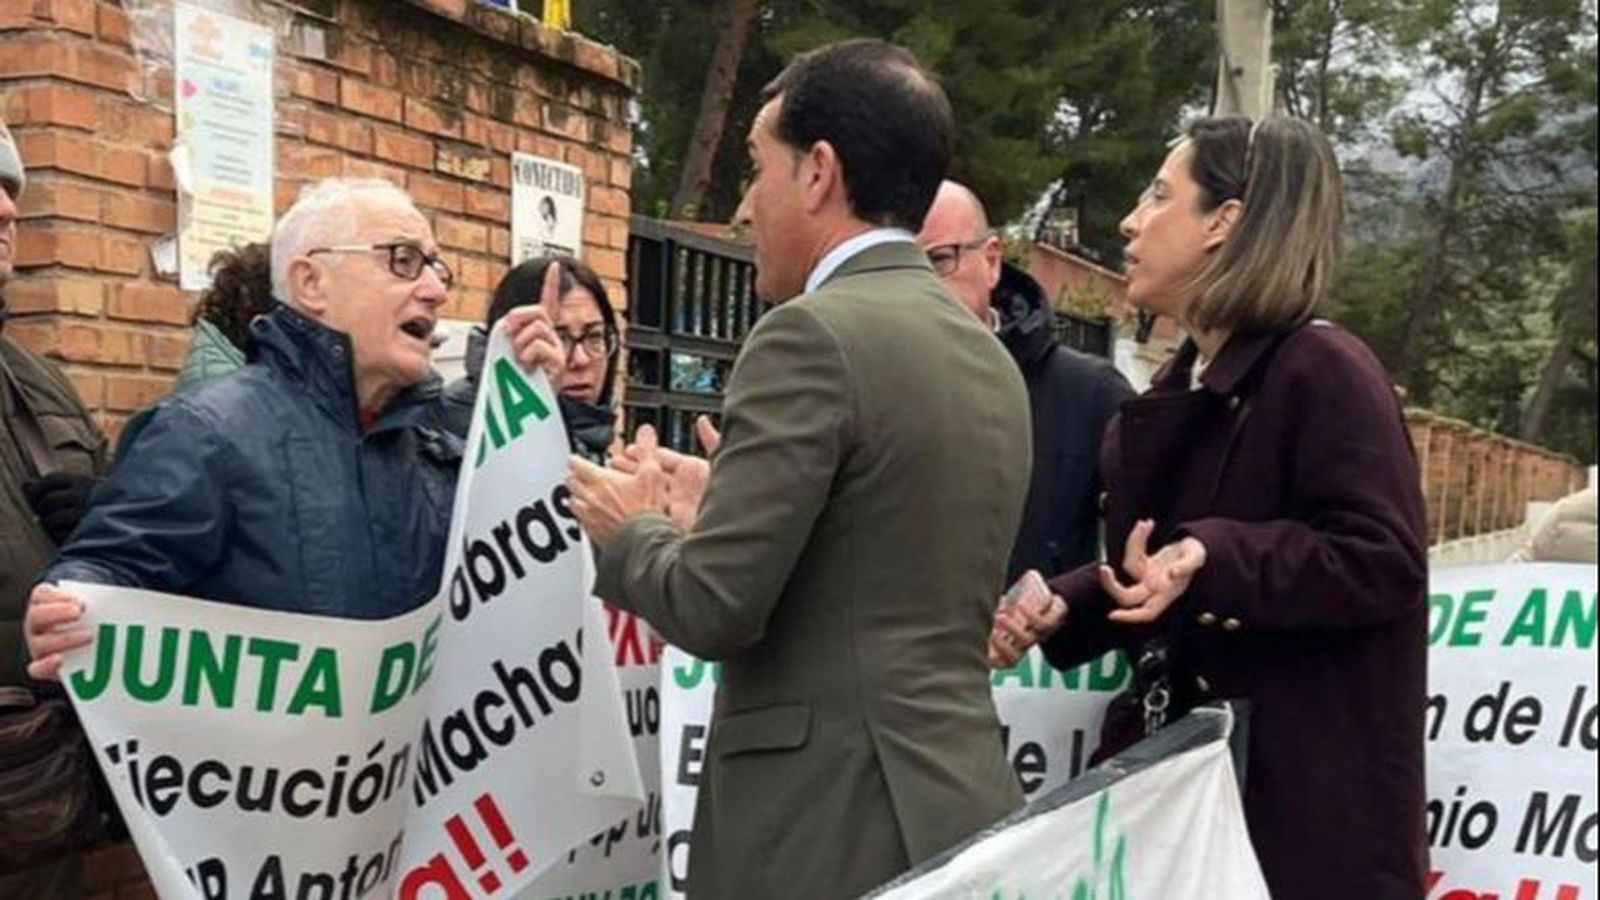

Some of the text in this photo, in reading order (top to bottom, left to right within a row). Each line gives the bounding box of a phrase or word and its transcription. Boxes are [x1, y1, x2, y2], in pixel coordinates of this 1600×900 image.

[70, 613, 443, 718] JUNTA DE
[1463, 681, 1543, 745] de
